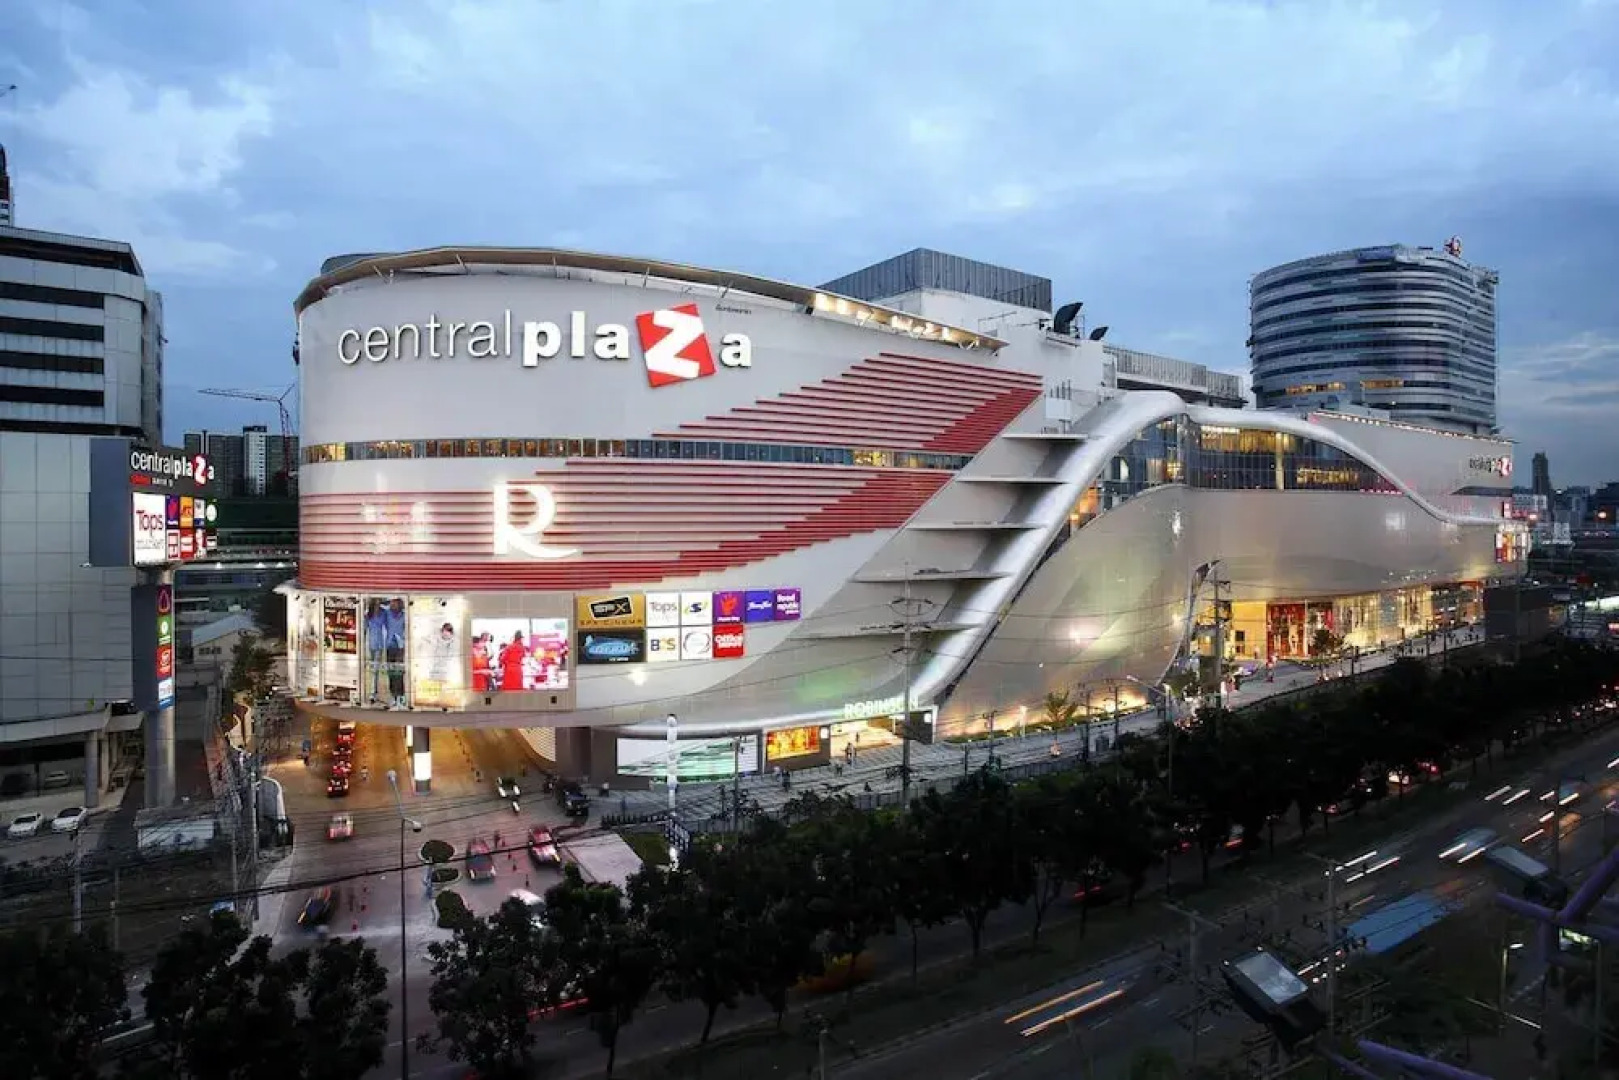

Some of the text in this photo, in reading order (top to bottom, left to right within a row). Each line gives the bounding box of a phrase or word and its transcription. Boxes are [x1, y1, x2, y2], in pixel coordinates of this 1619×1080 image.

[135, 510, 164, 537] Tops
[493, 483, 579, 558] R
[649, 601, 678, 615] Tops
